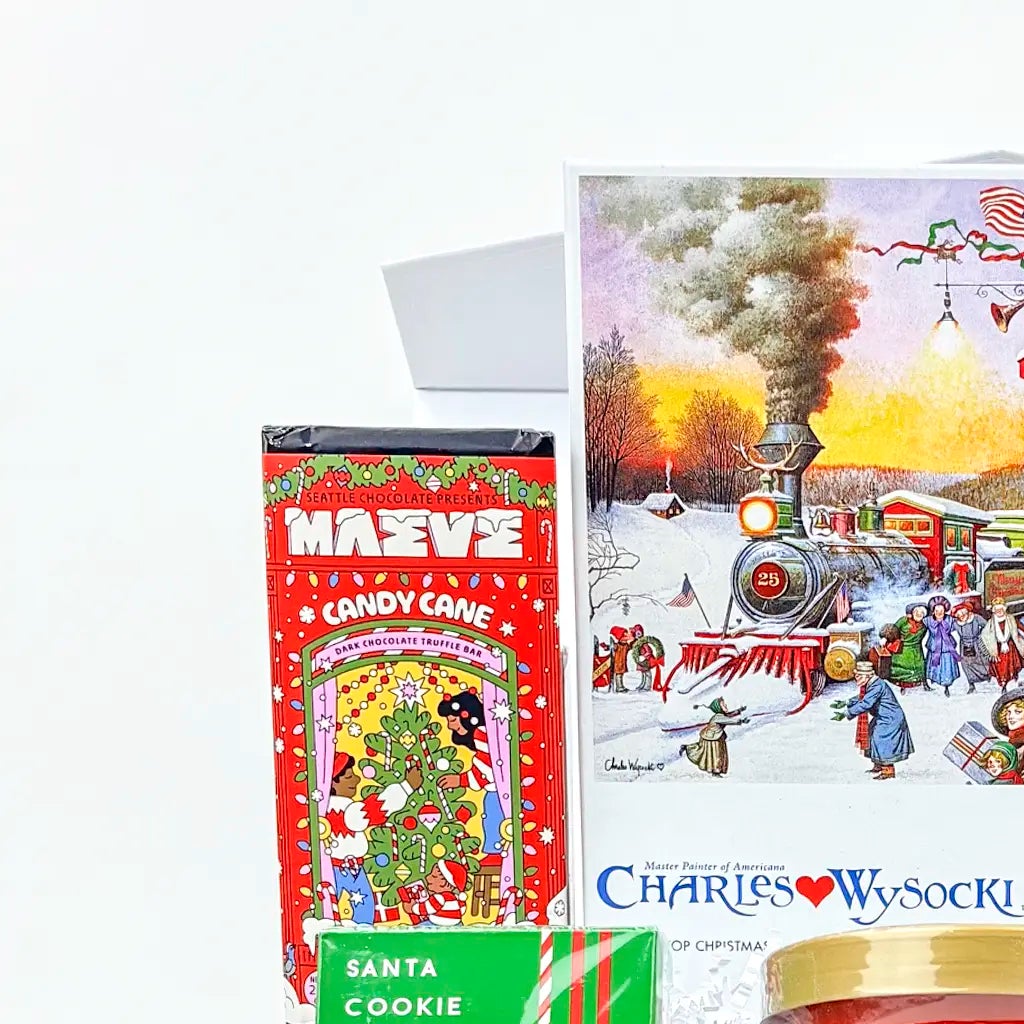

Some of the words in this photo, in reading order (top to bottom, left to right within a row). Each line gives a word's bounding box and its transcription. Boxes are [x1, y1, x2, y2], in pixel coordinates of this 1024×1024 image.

[306, 491, 355, 504] SEATTLE
[359, 492, 434, 505] CHOCOLATE
[436, 493, 498, 506] PRESENTS
[284, 507, 523, 558] MAEVE
[757, 571, 780, 587] 25
[321, 590, 416, 626] CANDY
[418, 591, 494, 630] CANE
[335, 641, 361, 655] DARK
[362, 636, 418, 649] CHOCOLATE
[421, 637, 460, 651] TRUFFLE
[463, 645, 482, 658] BAR
[644, 861, 679, 871] Master
[682, 861, 718, 871] Painter
[720, 861, 731, 873] of
[733, 861, 786, 872] Americana
[346, 958, 438, 978] SANTA
[344, 997, 462, 1017] COOKIE
